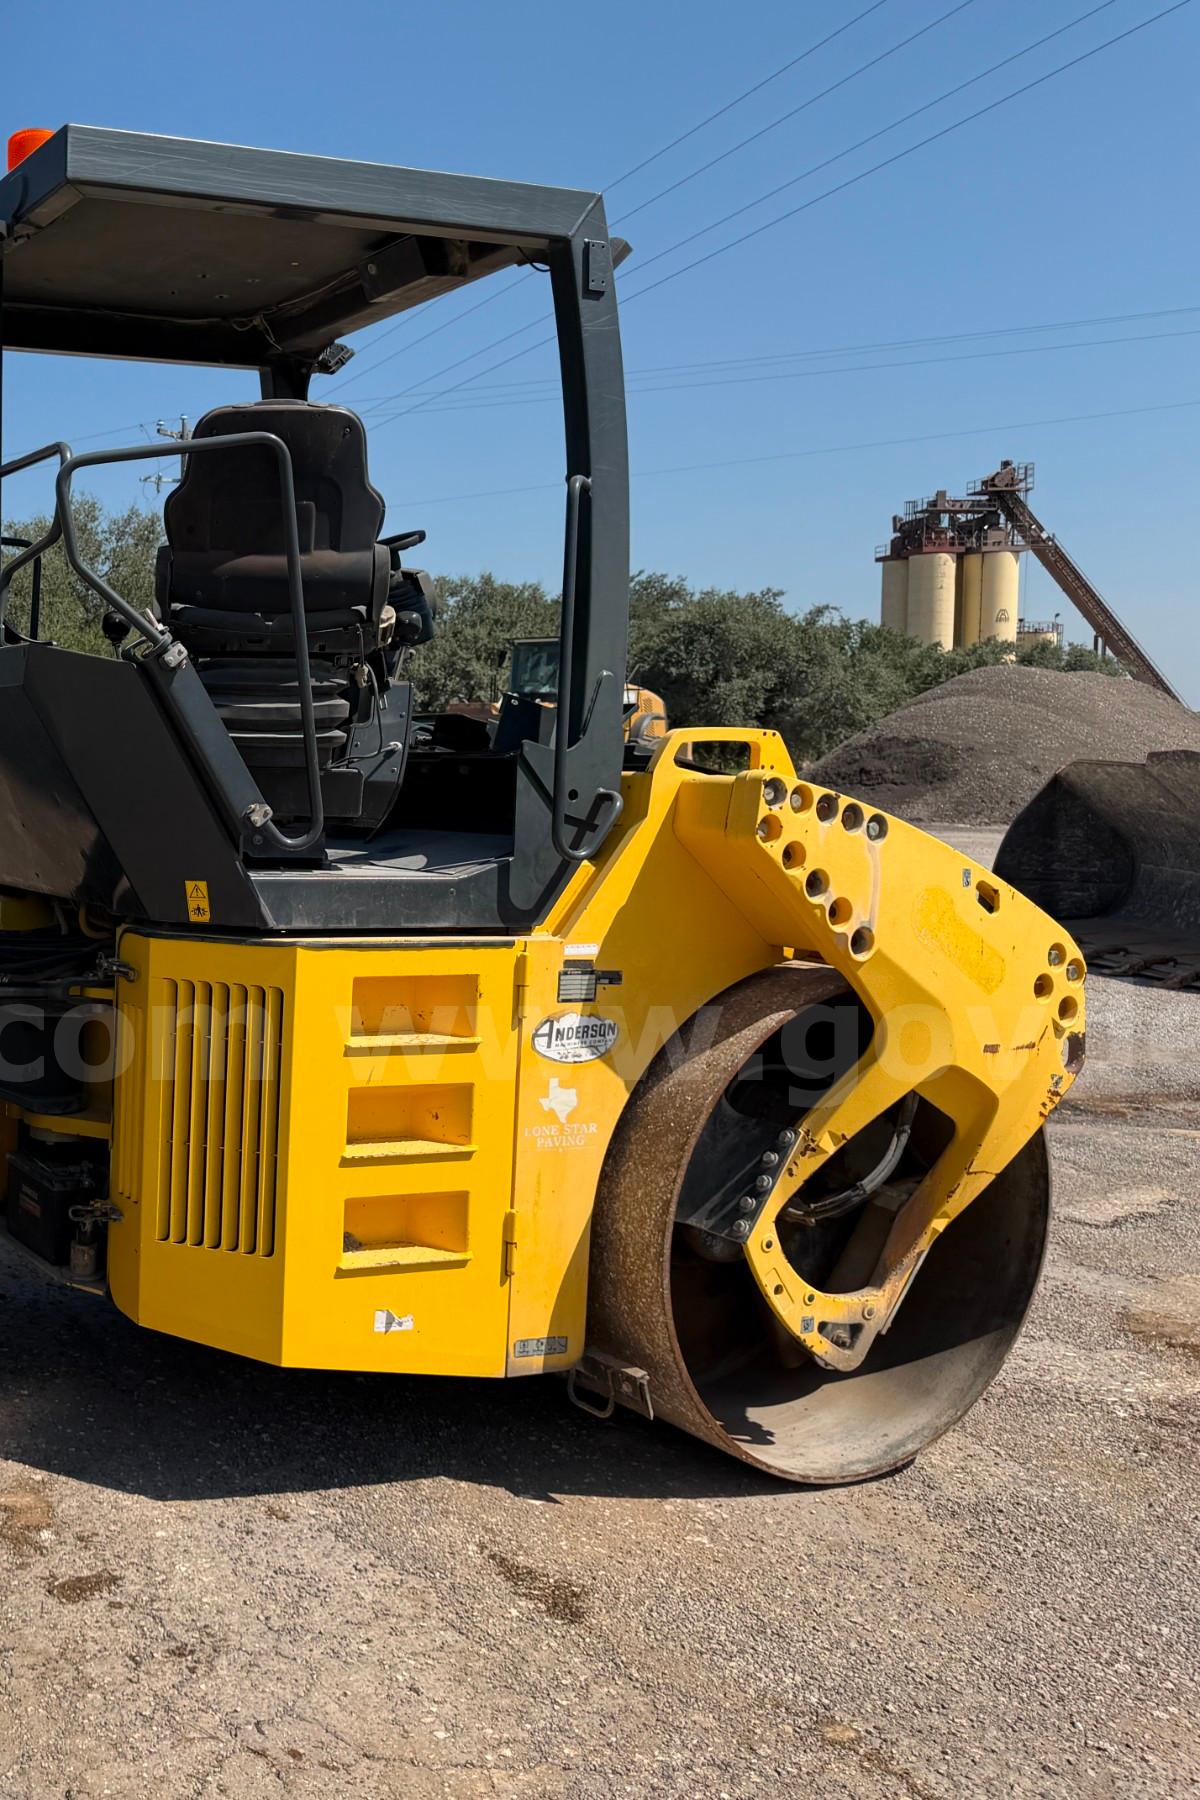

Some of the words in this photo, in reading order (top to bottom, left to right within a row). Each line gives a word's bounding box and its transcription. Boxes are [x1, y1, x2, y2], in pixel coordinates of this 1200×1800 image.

[533, 1019, 617, 1049] ANDERSON
[524, 1126, 560, 1137] LONE
[563, 1122, 599, 1134] STAR
[536, 1134, 585, 1148] PAVING
